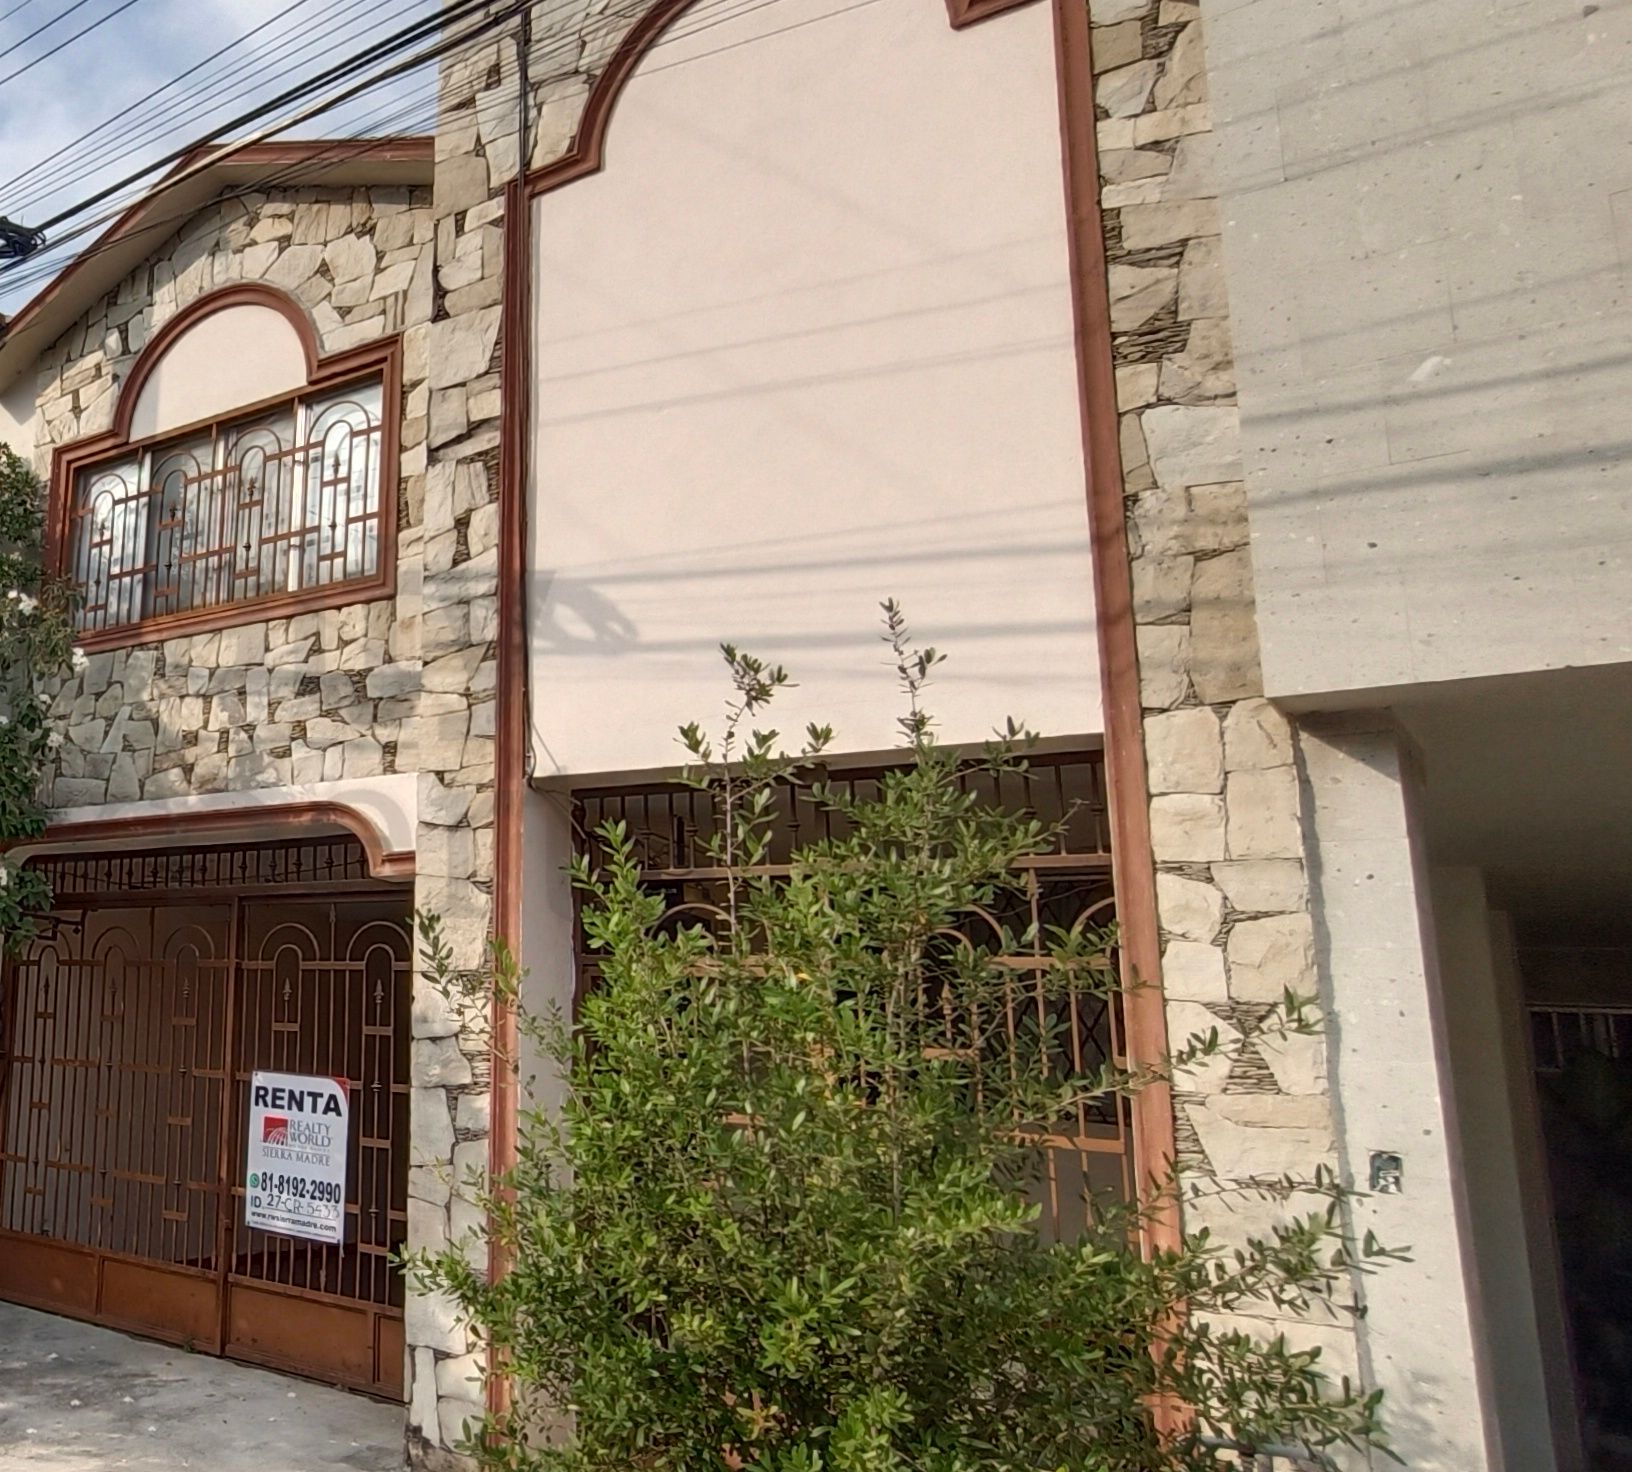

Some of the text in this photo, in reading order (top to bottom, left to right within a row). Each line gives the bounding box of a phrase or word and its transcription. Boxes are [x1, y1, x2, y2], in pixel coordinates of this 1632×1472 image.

[254, 1086, 342, 1117] RENTA
[289, 1120, 330, 1136] REALTY
[289, 1132, 331, 1148] WORLD
[262, 1148, 293, 1161] SIERRA
[296, 1151, 330, 1167] MADRE
[261, 1172, 341, 1204] 81-8192-2990
[250, 1211, 336, 1232] www.rwsierramadre.com
